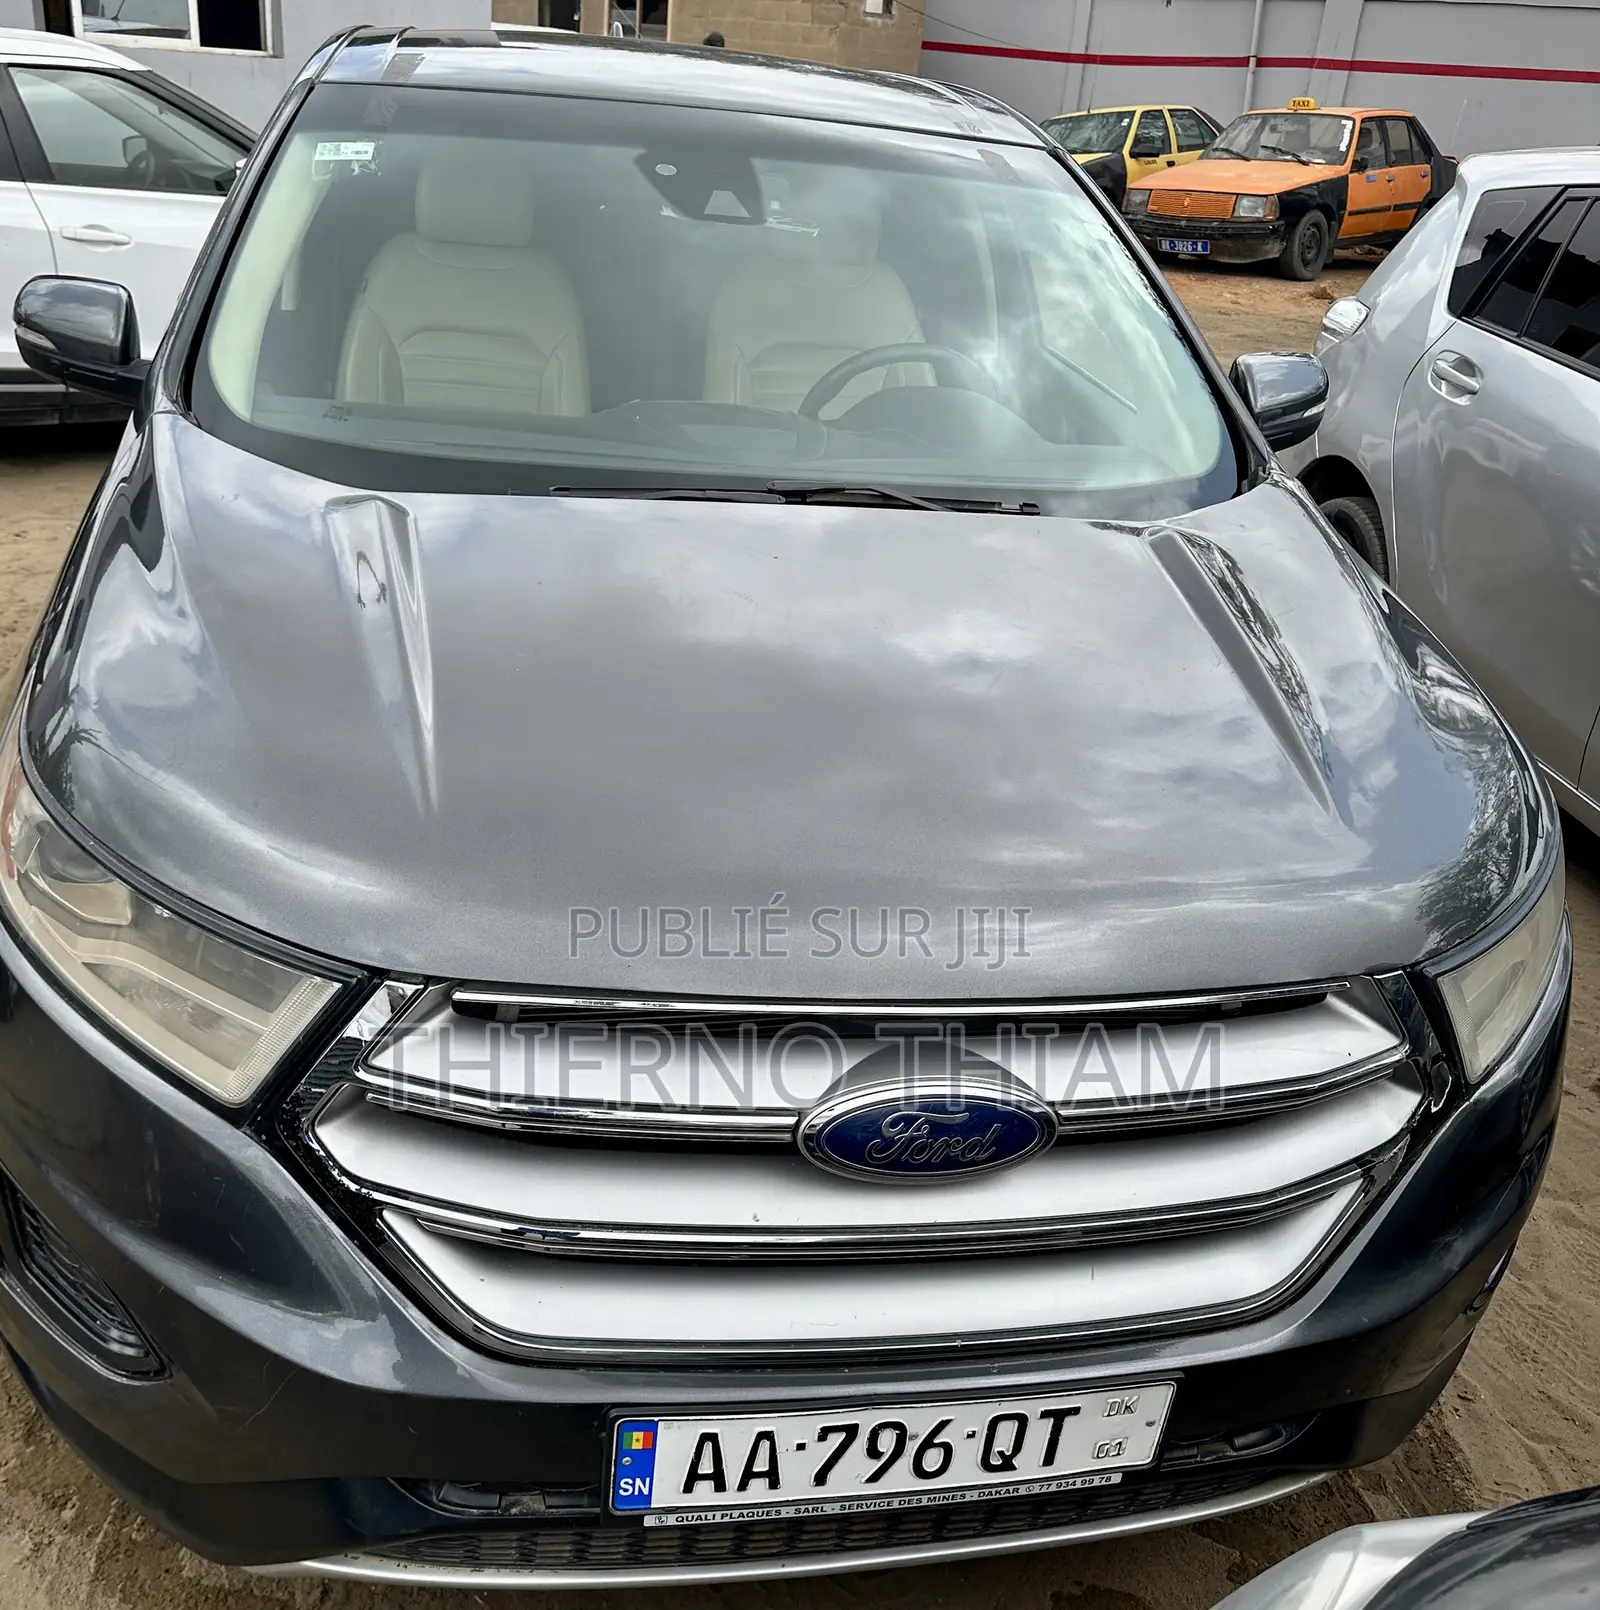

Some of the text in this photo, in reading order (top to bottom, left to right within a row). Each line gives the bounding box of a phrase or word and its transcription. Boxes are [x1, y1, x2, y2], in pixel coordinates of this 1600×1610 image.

[1291, 99, 1310, 107] TAXI
[865, 1111, 1001, 1164] Ford
[1102, 1396, 1140, 1417] DK
[619, 1478, 650, 1496] SN
[675, 1512, 716, 1523] QUALI
[720, 1509, 782, 1520] PLAQUES
[794, 1505, 827, 1514] SARL
[839, 1500, 894, 1511] SERVICE
[898, 1498, 923, 1506] DES
[927, 1493, 967, 1503] MINES
[978, 1486, 1020, 1498] DAKAR
[1038, 1484, 1053, 1492] 77
[1056, 1480, 1077, 1489] 934
[1080, 1477, 1095, 1486] 99
[1098, 1475, 1112, 1484] 78
